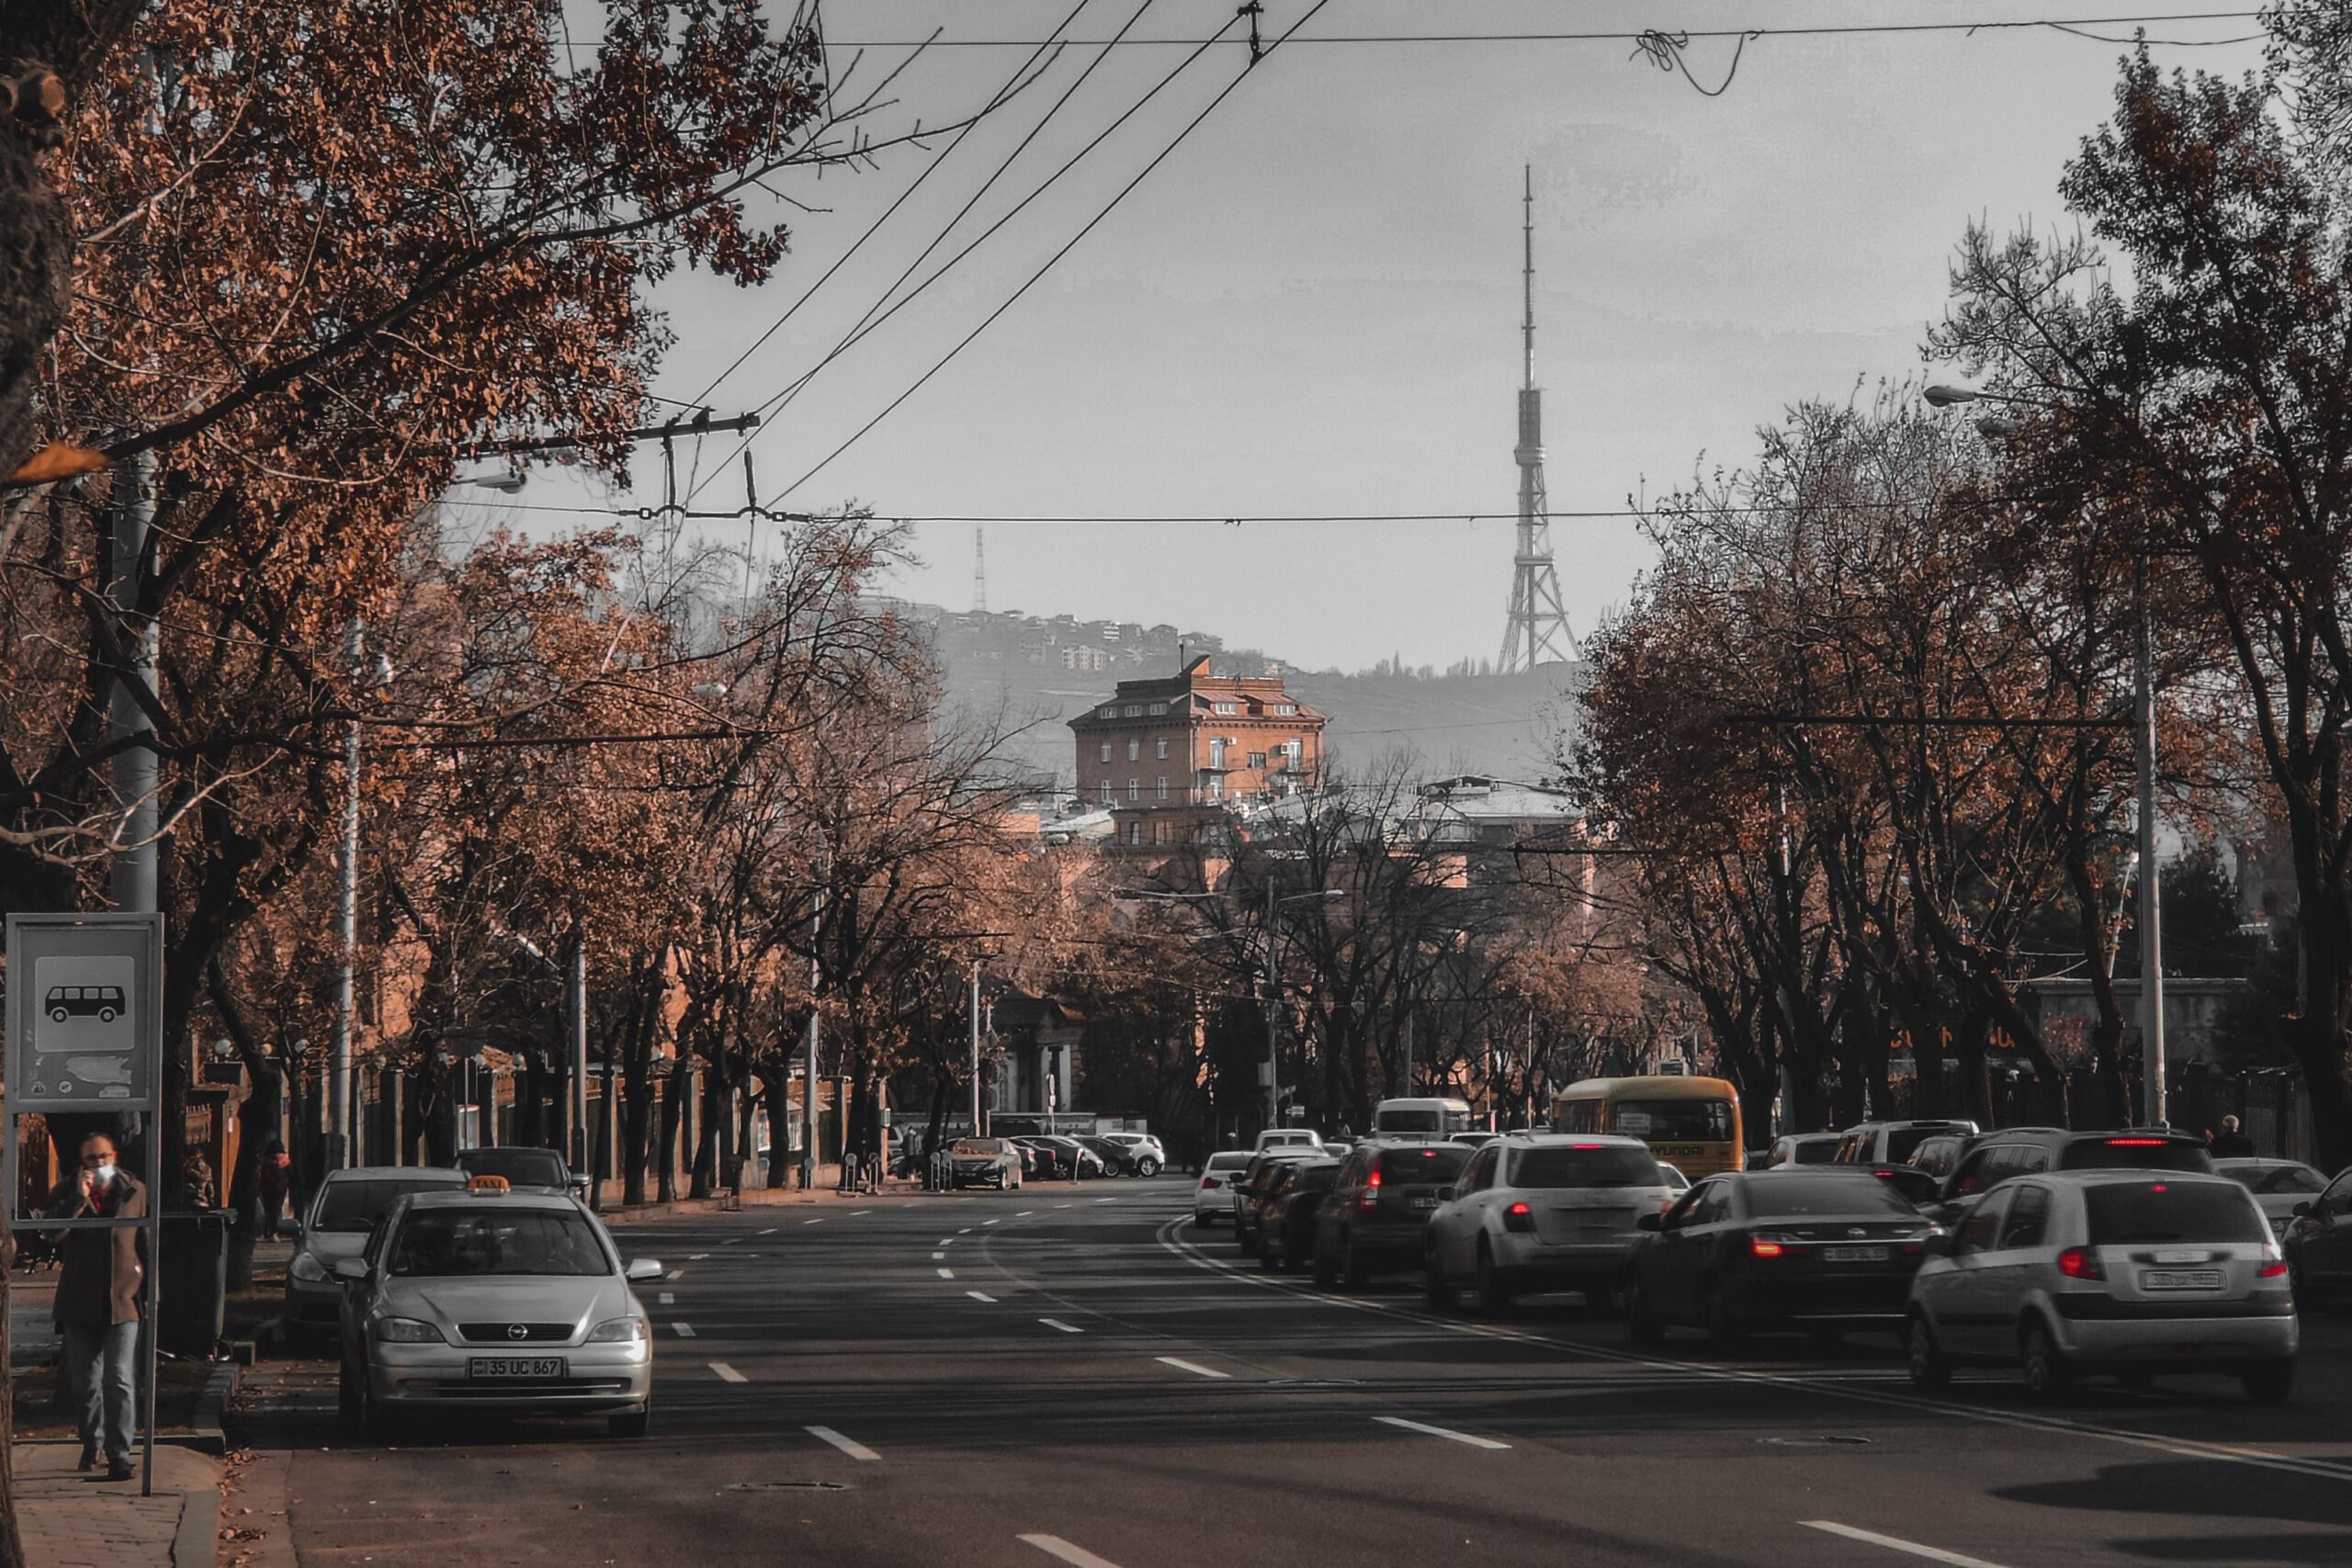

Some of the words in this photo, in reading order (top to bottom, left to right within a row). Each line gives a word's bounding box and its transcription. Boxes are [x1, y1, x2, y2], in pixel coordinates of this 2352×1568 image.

[475, 1179, 503, 1189] TAXI
[490, 1360, 506, 1375] 35
[510, 1360, 529, 1375] UC
[534, 1359, 558, 1375] 867
